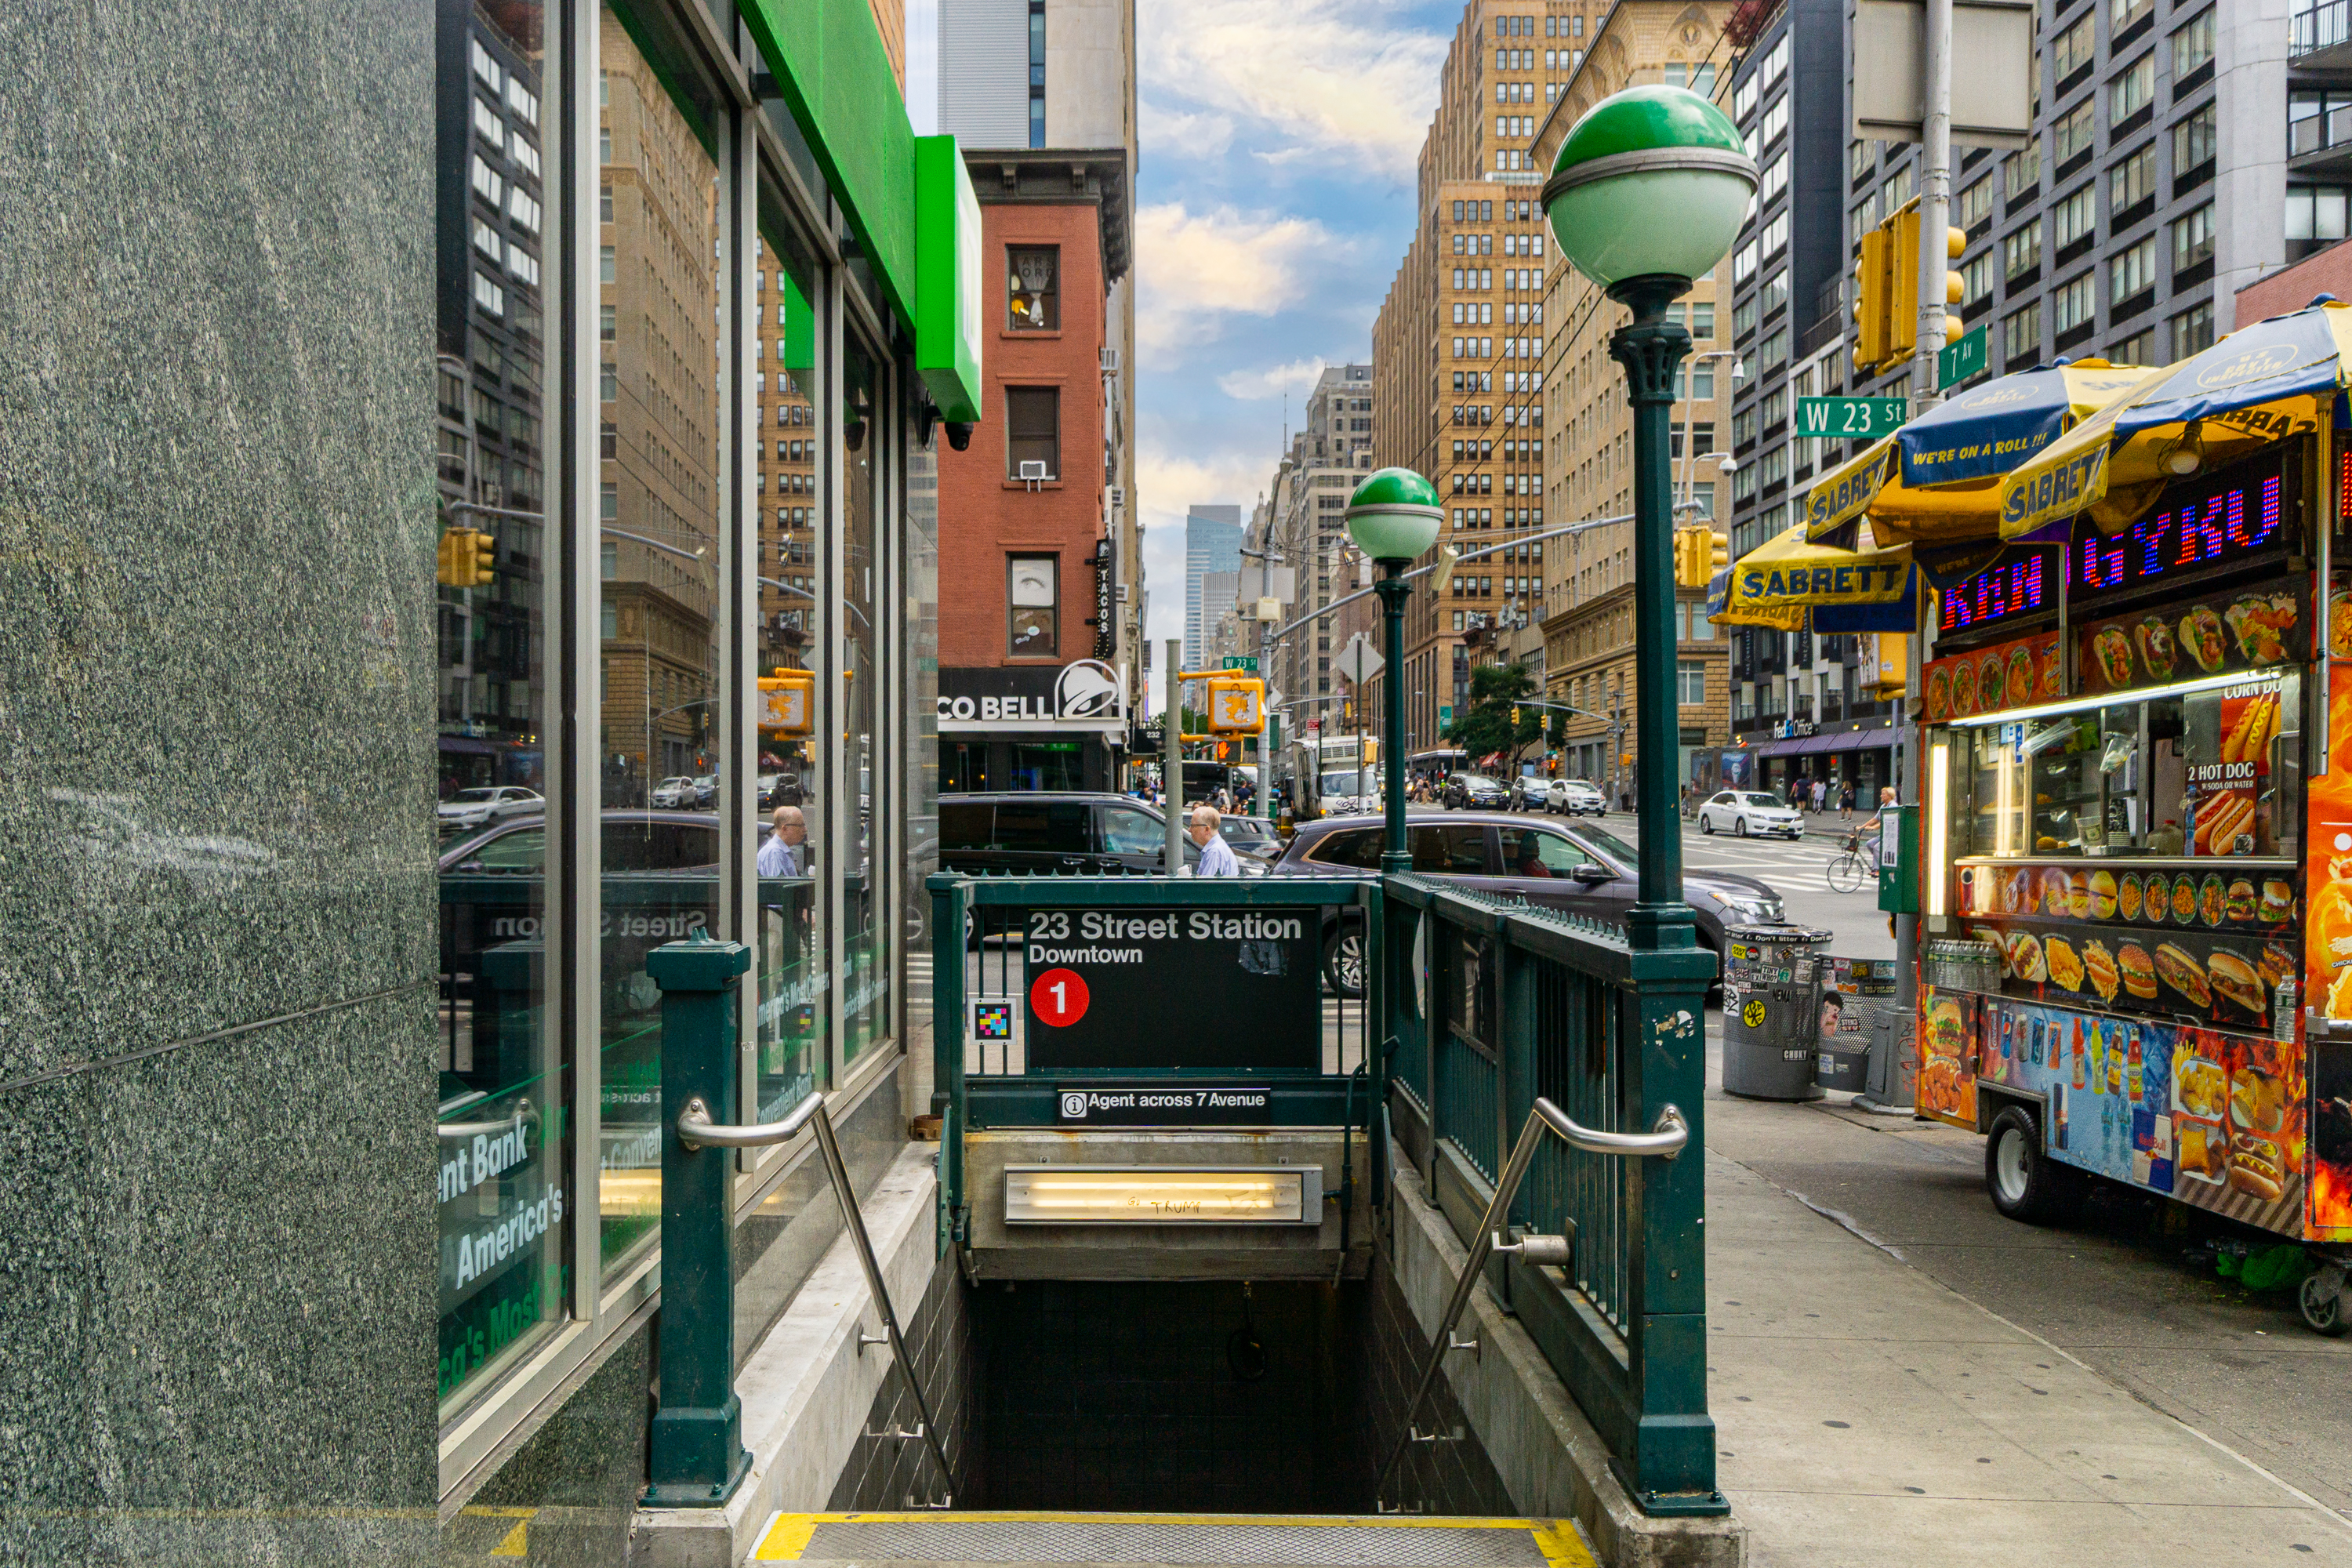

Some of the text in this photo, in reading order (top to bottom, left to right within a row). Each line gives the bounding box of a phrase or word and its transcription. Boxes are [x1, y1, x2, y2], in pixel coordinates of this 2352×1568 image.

[1951, 342, 1973, 379] 7 Av
[1806, 402, 1901, 432] W 23 St
[1913, 448, 1956, 465] WE'RE
[1959, 445, 1979, 459] ON
[1981, 444, 1991, 456] A
[1994, 437, 2028, 454] ROLL
[1740, 564, 1902, 598] SABRETT
[1100, 569, 1109, 633] TACOS
[1225, 659, 1234, 669] W
[1236, 659, 1247, 669] 23
[2223, 681, 2259, 700] CORN
[982, 696, 1054, 720] BELL
[1773, 718, 1813, 739] FedEx Office
[2188, 761, 2255, 782] 2 HOT DOG
[1030, 912, 1301, 939] 23 Street Station
[1029, 944, 1143, 963] Downtown
[1762, 966, 1779, 975] TINY
[1051, 982, 1065, 1014] 1
[1784, 1050, 1807, 1058] CHUKY
[1088, 1093, 1265, 1110] Agent across 7 Avenue
[473, 1115, 528, 1188] Bank
[1151, 1200, 1202, 1214] TRUMP
[456, 1182, 563, 1290] America's
